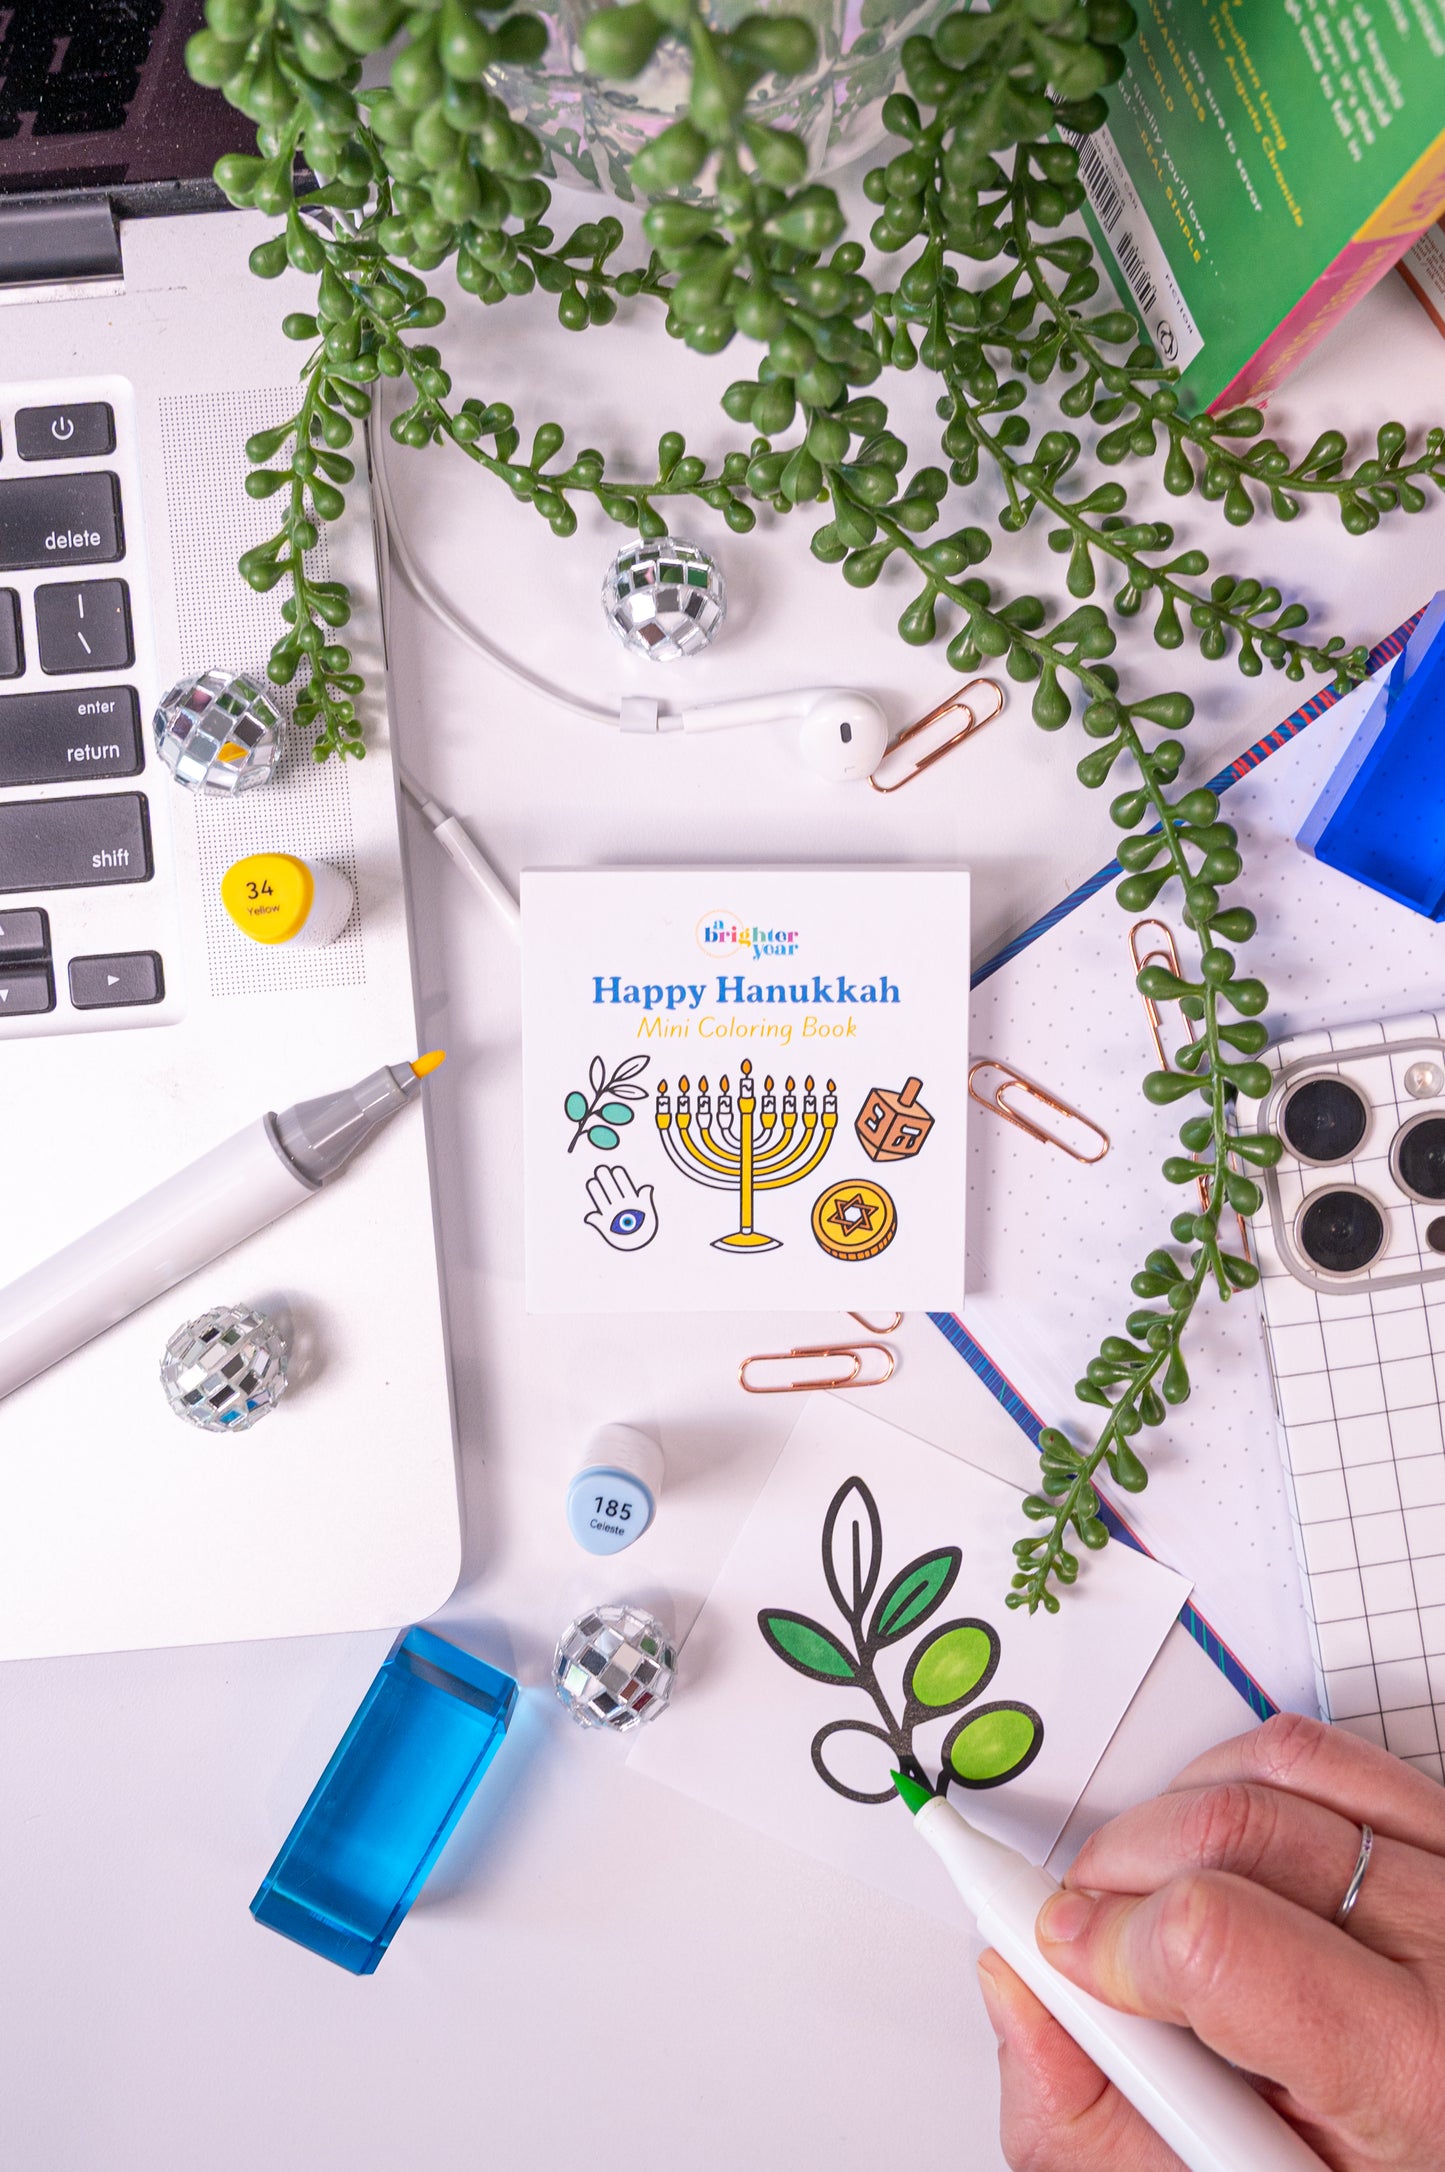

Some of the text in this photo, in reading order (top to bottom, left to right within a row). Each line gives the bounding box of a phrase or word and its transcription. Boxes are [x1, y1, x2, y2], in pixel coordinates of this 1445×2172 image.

[1140, 33, 1174, 112] WORLD
[1222, 2, 1287, 150] Southern Living
[1338, 17, 1392, 128] She could
[1300, 26, 1322, 72] time
[1320, 74, 1333, 99] to
[1332, 99, 1353, 138] fall
[1348, 139, 1361, 162] in
[1189, 51, 1262, 211] are sure to savor
[1210, 15, 1303, 227] The Augusta Chronicle
[1355, 108, 1375, 144] the
[1134, 84, 1205, 241] quality you’ll love
[1166, 186, 1202, 264] SIMPLE
[1166, 274, 1192, 334] FICTION
[45, 529, 101, 550] delete
[77, 700, 116, 715] enter
[66, 743, 120, 762] return
[92, 848, 130, 868] shift
[245, 879, 275, 900] 34
[247, 904, 281, 917] Yellow
[713, 919, 725, 930] a
[704, 925, 799, 948] brighter
[753, 943, 799, 961] year
[592, 975, 901, 1011] Happy Hanukkah
[636, 1015, 858, 1047] Mini Coloring Book
[594, 1495, 633, 1522] 185
[589, 1518, 625, 1537] Celeste
